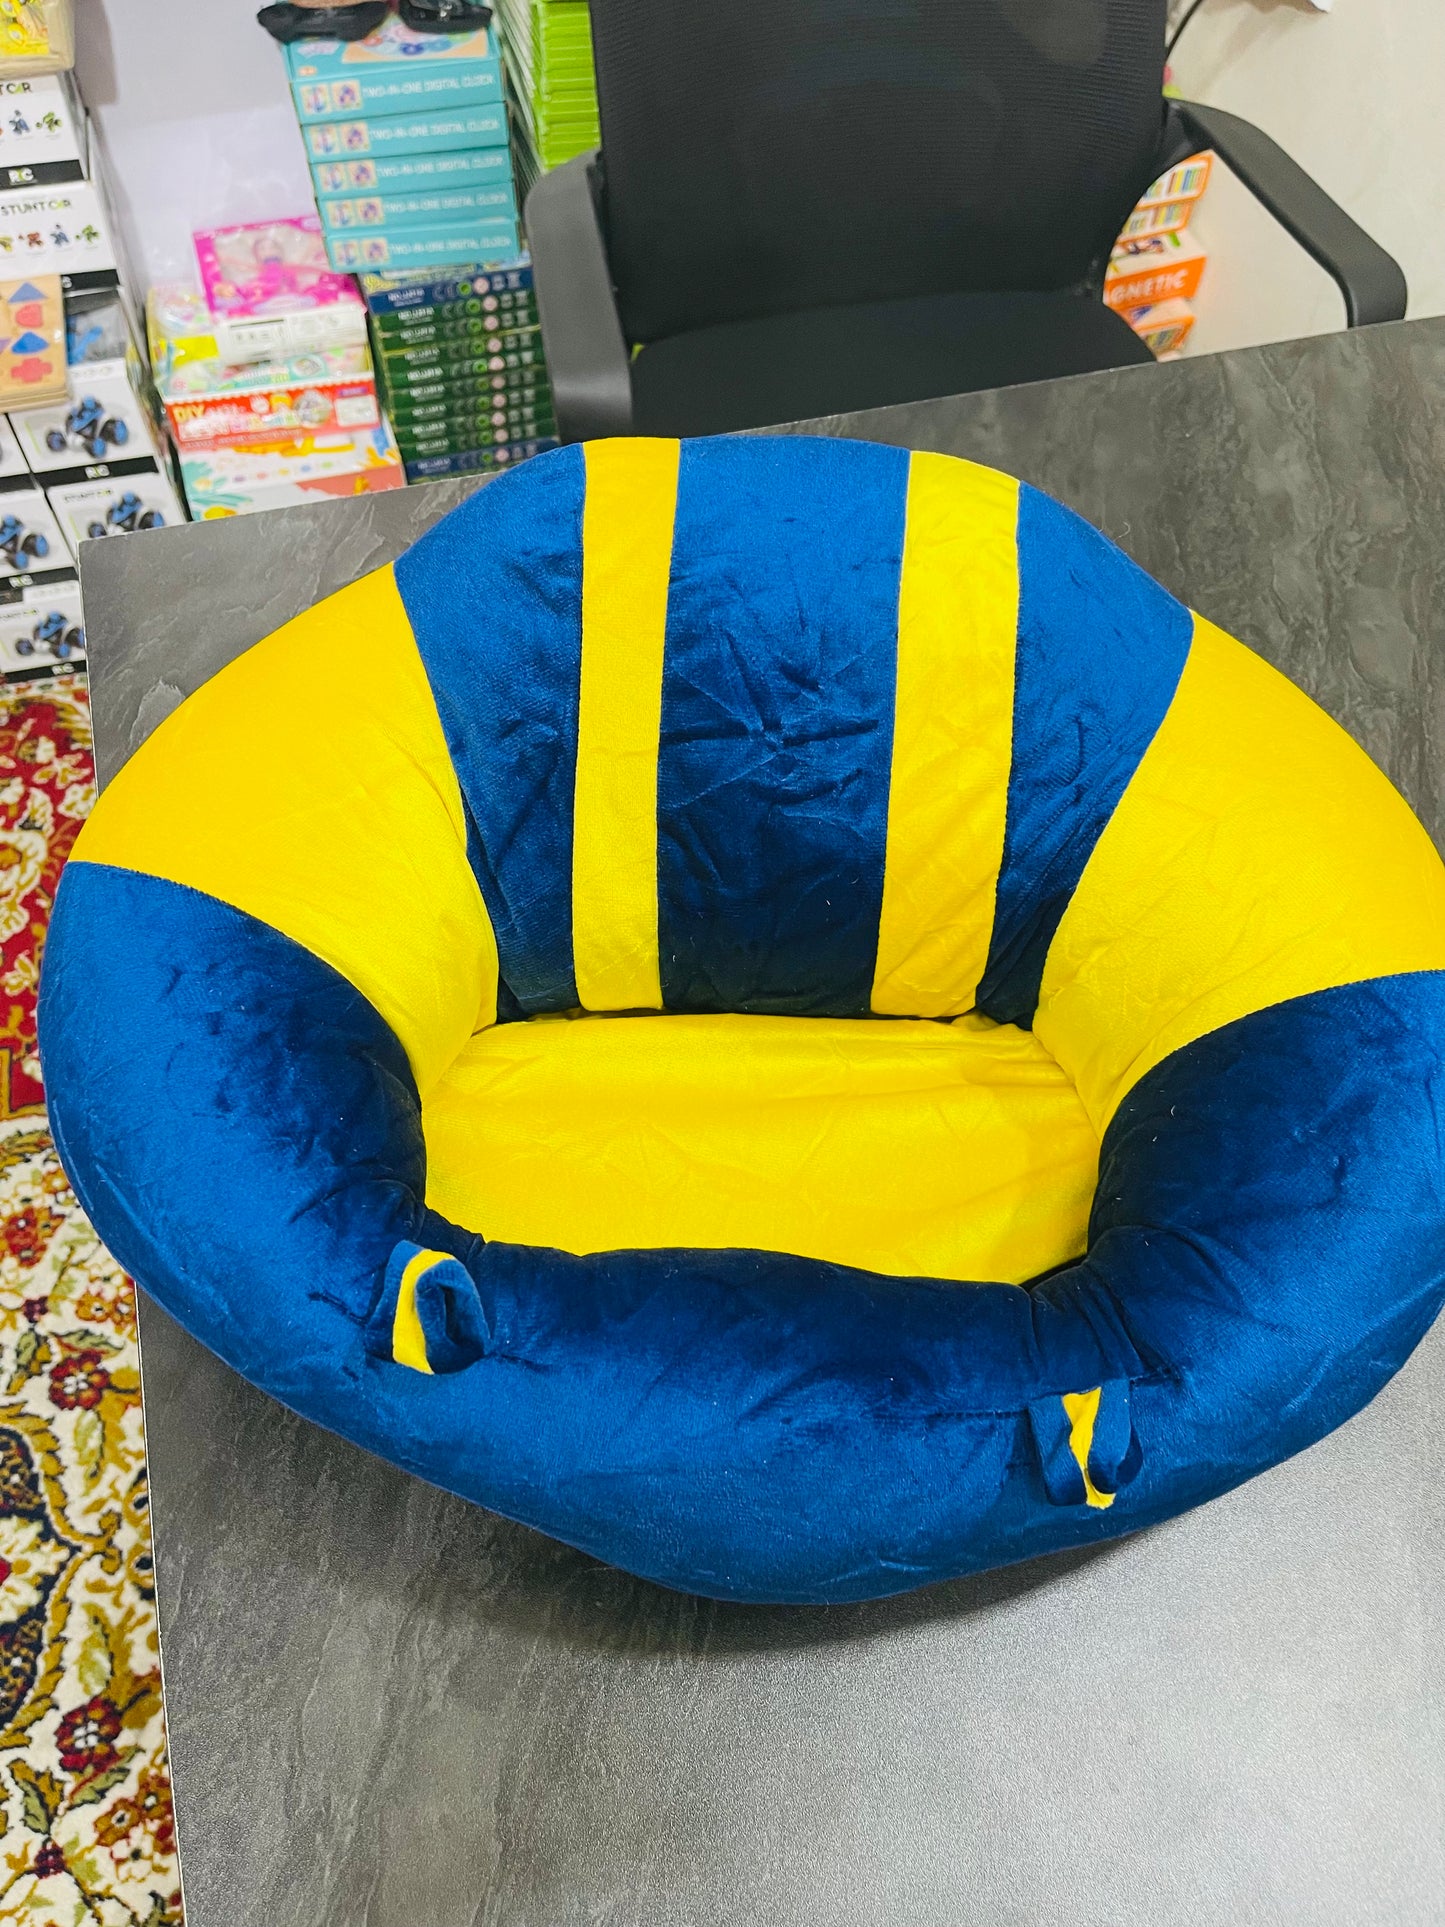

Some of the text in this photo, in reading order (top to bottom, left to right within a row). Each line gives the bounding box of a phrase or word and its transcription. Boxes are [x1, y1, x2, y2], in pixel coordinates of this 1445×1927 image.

[424, 78, 460, 92] DIGITAL
[1110, 268, 1188, 303] GNETIC
[172, 403, 205, 423] DIY
